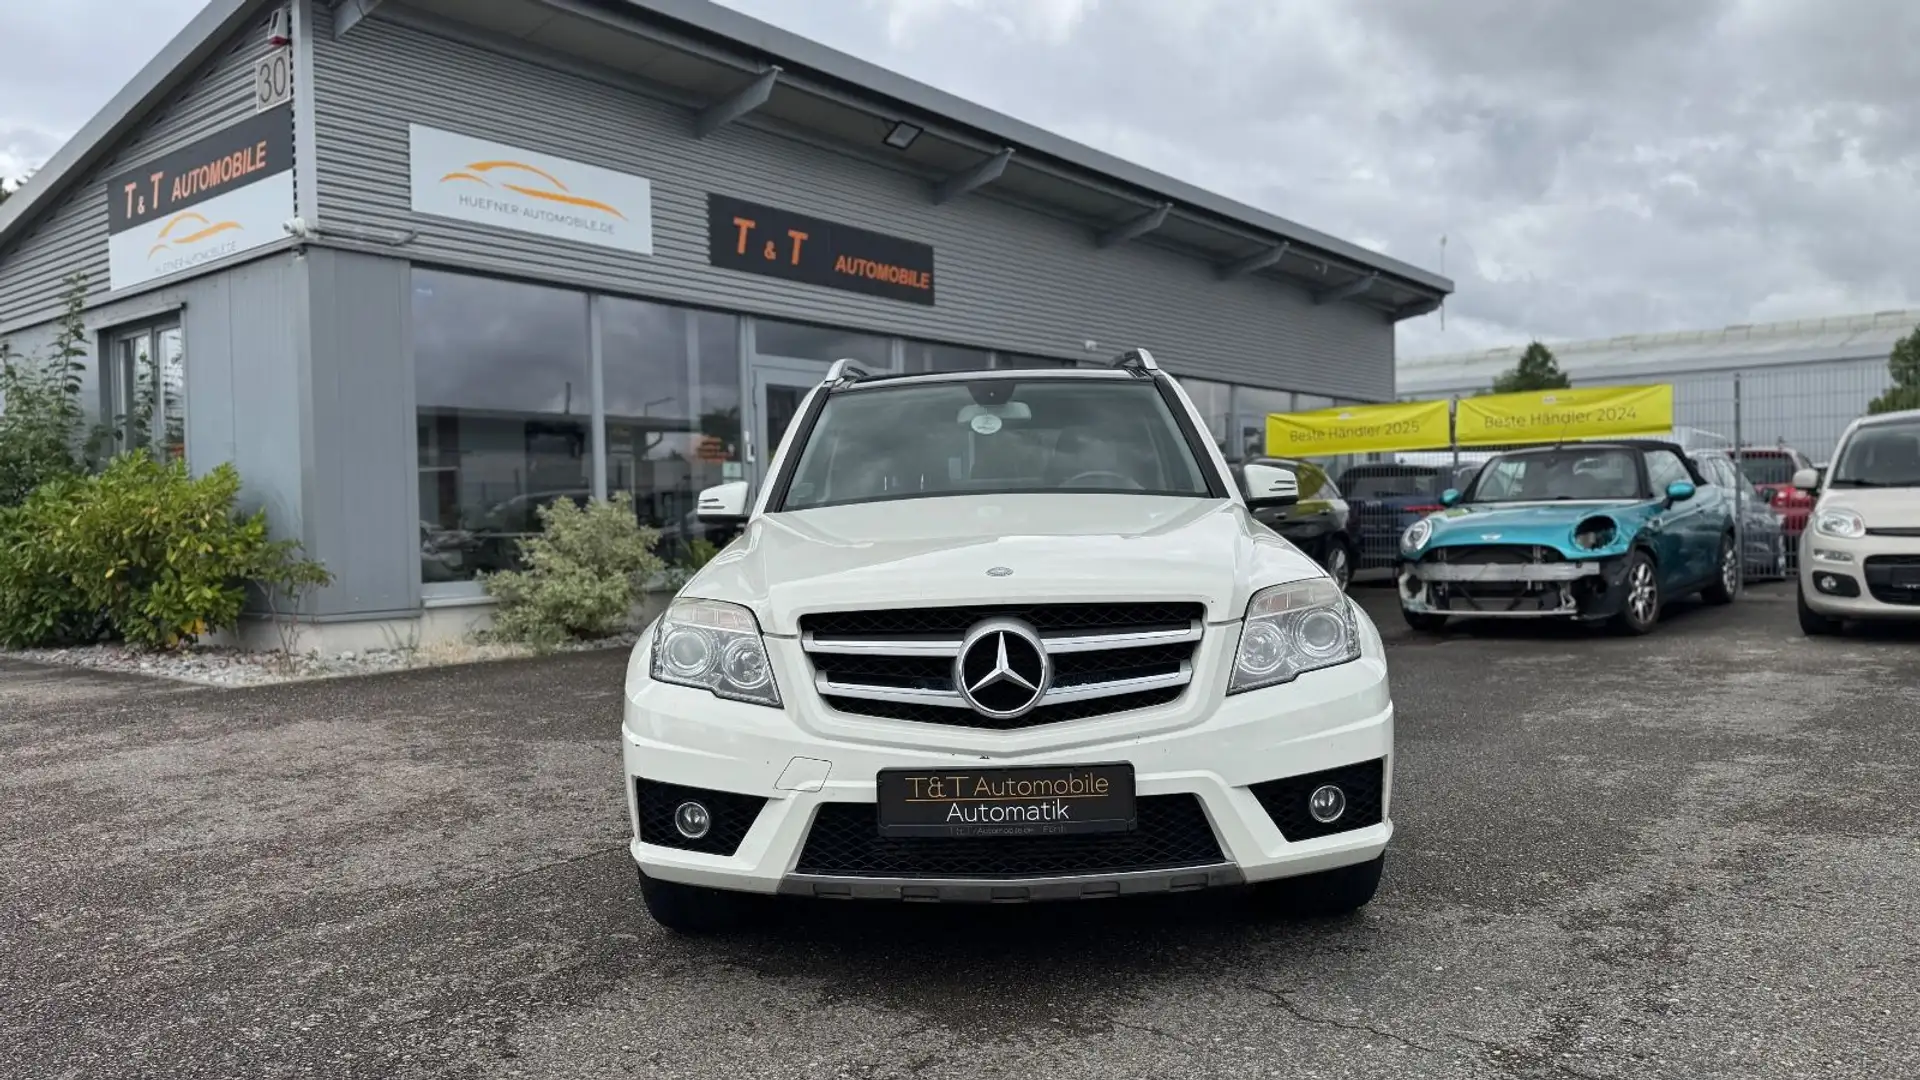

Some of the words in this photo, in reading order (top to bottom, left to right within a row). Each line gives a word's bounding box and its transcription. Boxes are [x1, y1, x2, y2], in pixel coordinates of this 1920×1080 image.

[259, 57, 286, 103] 30
[125, 182, 137, 219] T
[137, 196, 145, 214] &
[151, 171, 163, 209] T
[171, 140, 267, 202] AUTOMOBILE
[733, 216, 756, 254] T
[764, 240, 777, 260] &
[788, 229, 808, 265] T
[835, 255, 930, 289] AUTOMOBILE
[1484, 413, 1526, 429] Beste
[1530, 411, 1592, 426] Händler
[1596, 406, 1637, 422] 2024
[1289, 428, 1326, 442] Beste
[1328, 424, 1381, 440] Händler
[1384, 420, 1420, 436] 2025
[905, 776, 970, 798] T&T
[973, 772, 1109, 797] Automobile
[946, 799, 1069, 822] Automatik
